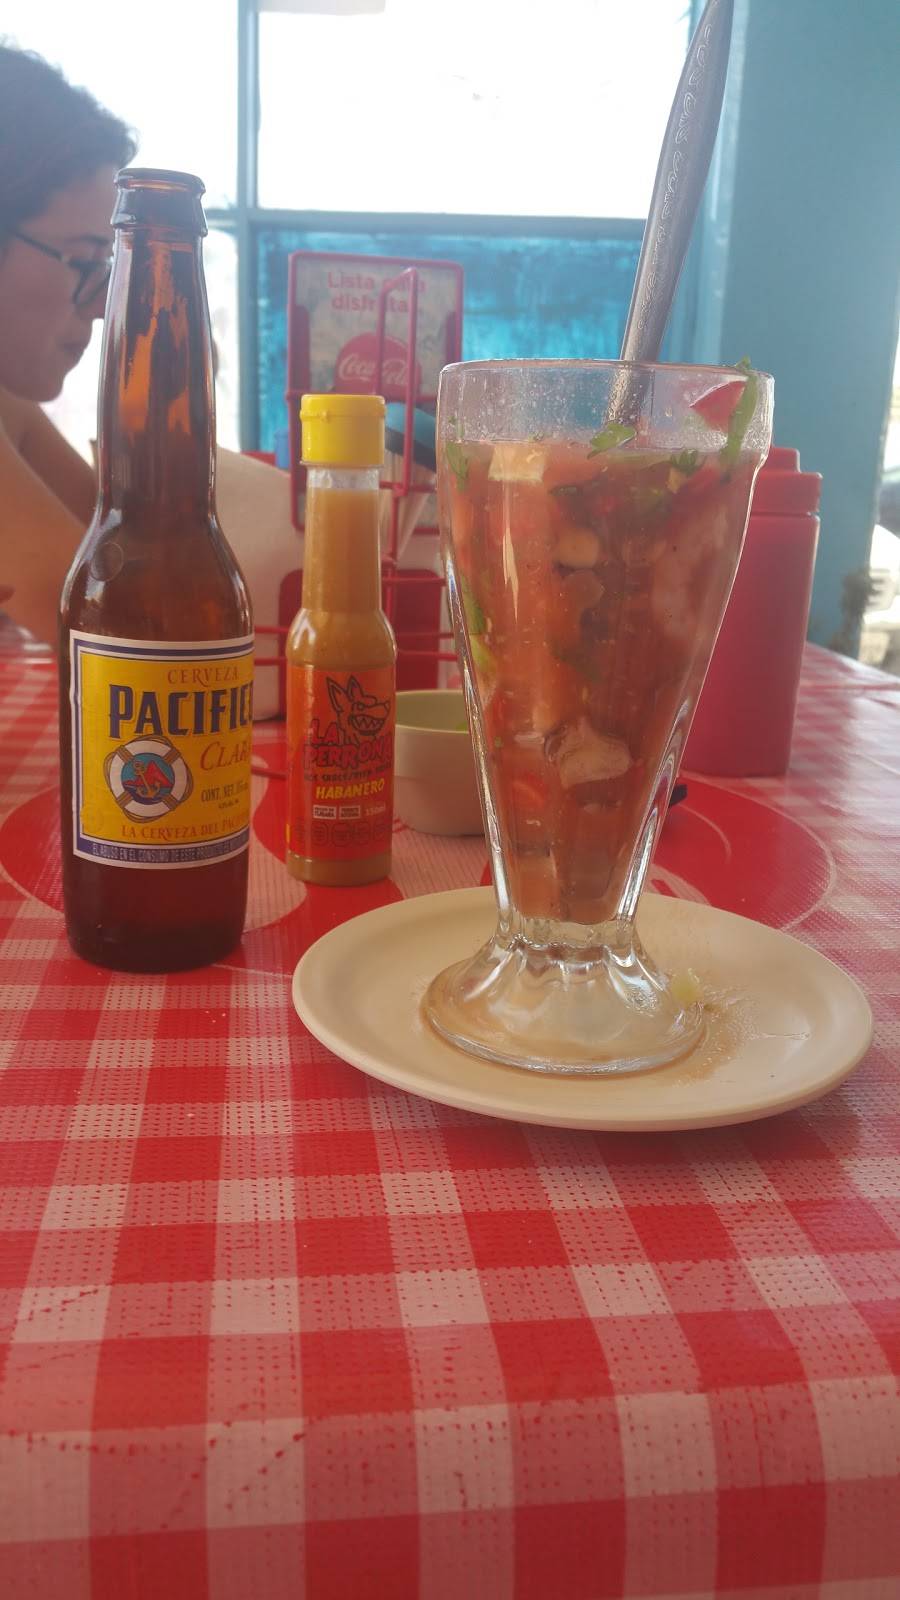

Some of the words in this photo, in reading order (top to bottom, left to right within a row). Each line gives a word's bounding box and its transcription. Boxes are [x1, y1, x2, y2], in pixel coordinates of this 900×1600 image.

[327, 271, 375, 291] Lista
[167, 666, 239, 687] CERVEZA
[310, 718, 340, 747] LA
[315, 778, 385, 800] HABANERO
[121, 824, 137, 838] LA
[141, 825, 197, 841] CERVEZA
[200, 823, 219, 836] DEL
